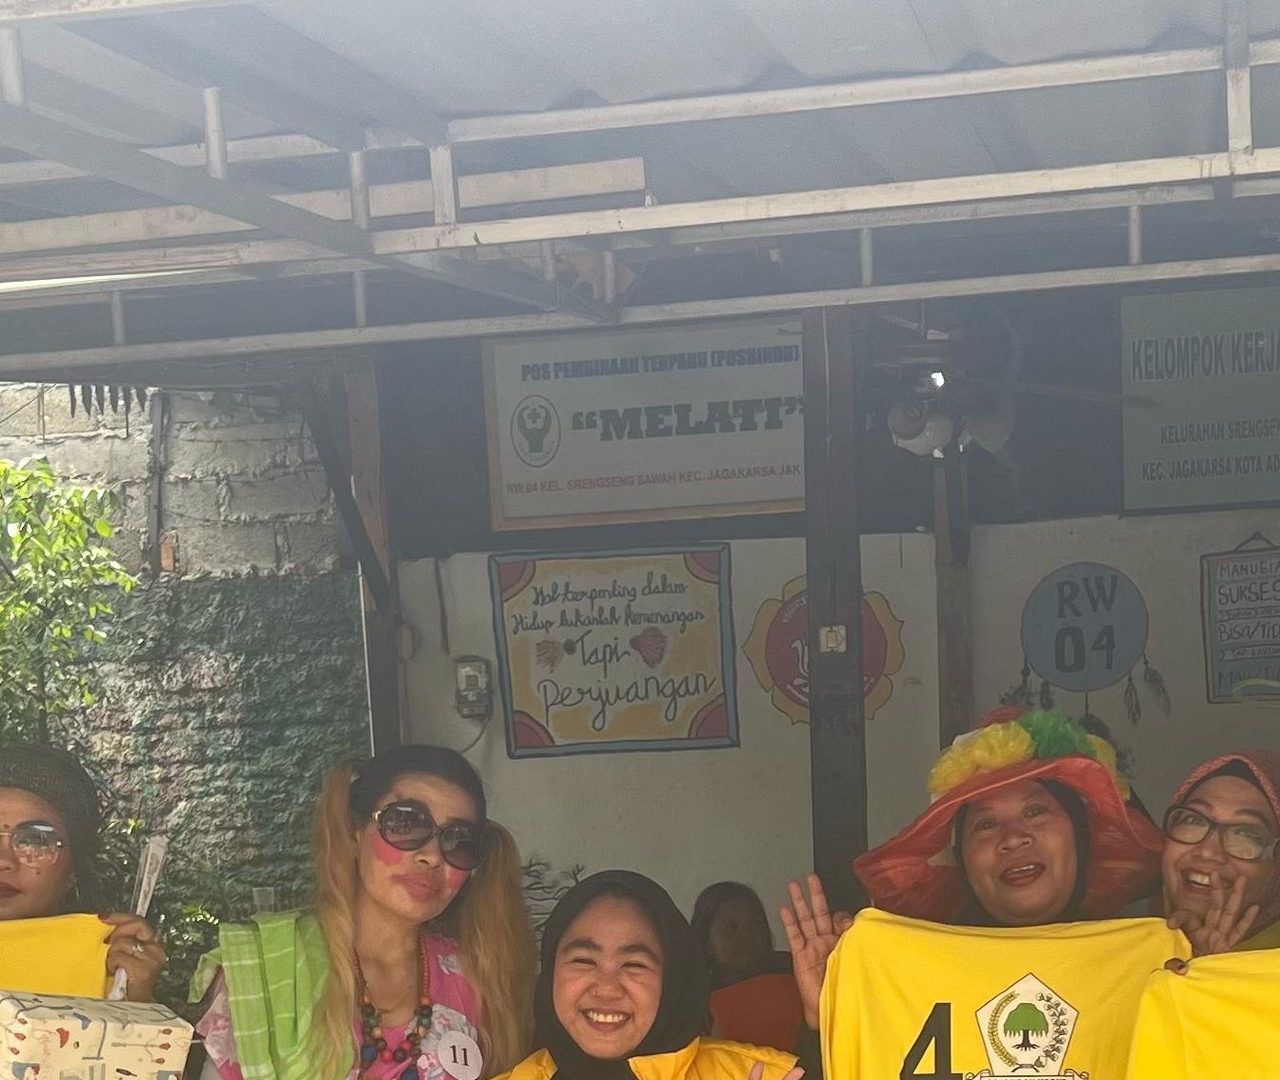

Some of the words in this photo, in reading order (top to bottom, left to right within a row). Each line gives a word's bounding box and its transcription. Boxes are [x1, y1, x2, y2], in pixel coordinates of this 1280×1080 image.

[1131, 333, 1225, 382] KELOMPOK
[521, 362, 551, 381] POS
[1160, 423, 1225, 445] KELURAHAN
[567, 474, 635, 491] SRENGSENG
[637, 472, 677, 486] SAWAH
[706, 465, 776, 482] JAGAKARSA
[1142, 462, 1167, 481] KEC.
[1169, 458, 1232, 479] JAGAKARSA
[1235, 455, 1263, 474] KOTA
[642, 572, 688, 595] dalam
[1056, 574, 1119, 620] RW
[511, 614, 554, 635] Hidup
[574, 630, 631, 678] Tapi
[1054, 625, 1116, 674] 04
[450, 1045, 469, 1066] 11
